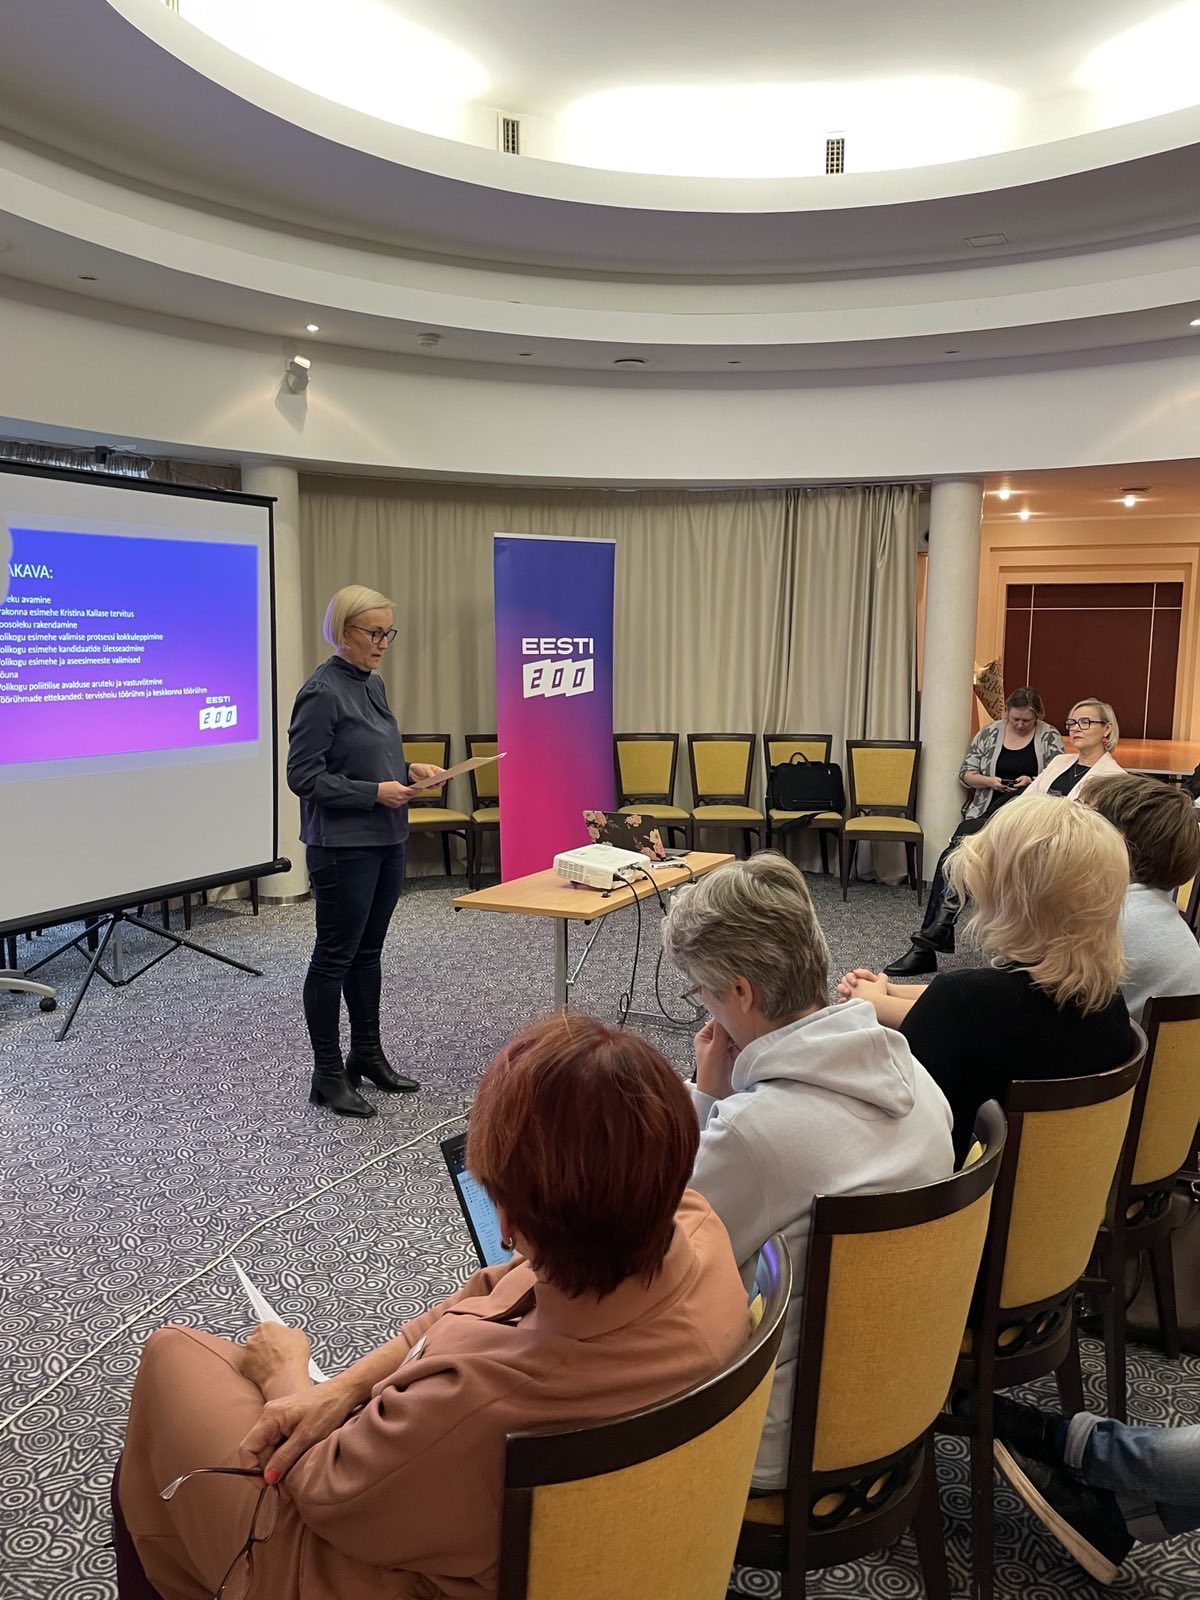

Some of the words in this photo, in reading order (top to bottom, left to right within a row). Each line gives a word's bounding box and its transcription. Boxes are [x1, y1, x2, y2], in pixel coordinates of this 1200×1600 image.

[21, 596, 51, 604] avamine
[29, 608, 59, 616] esimehe
[60, 609, 85, 617] Kristina
[86, 609, 109, 617] Kallase
[110, 610, 134, 618] tervitus
[33, 621, 78, 629] rakendamine
[27, 633, 57, 641] esimehe
[58, 633, 86, 641] valimise
[87, 633, 116, 642] protsessi
[117, 633, 163, 642] kokkuleppimine
[28, 645, 57, 653] esimehe
[59, 645, 101, 653] kandidaatide
[522, 637, 594, 655] EESTI
[0, 658, 26, 667] olikogu
[28, 657, 58, 666] esimehe
[59, 658, 65, 666] ja
[67, 657, 110, 665] aseesimeeste
[112, 656, 141, 664] valimised
[0, 682, 28, 692] olikogu
[29, 682, 60, 691] poliitilise
[61, 681, 90, 689] avalduse
[91, 680, 115, 688] arutelu
[116, 680, 122, 688] ja
[123, 678, 163, 686] vastuvõtmine
[44, 692, 84, 702] ettekanded:
[85, 690, 117, 699] tervishoiu
[118, 690, 145, 698] töörühm
[146, 689, 152, 698] ja
[153, 688, 182, 696] keskkonna
[206, 696, 231, 704] EESTI
